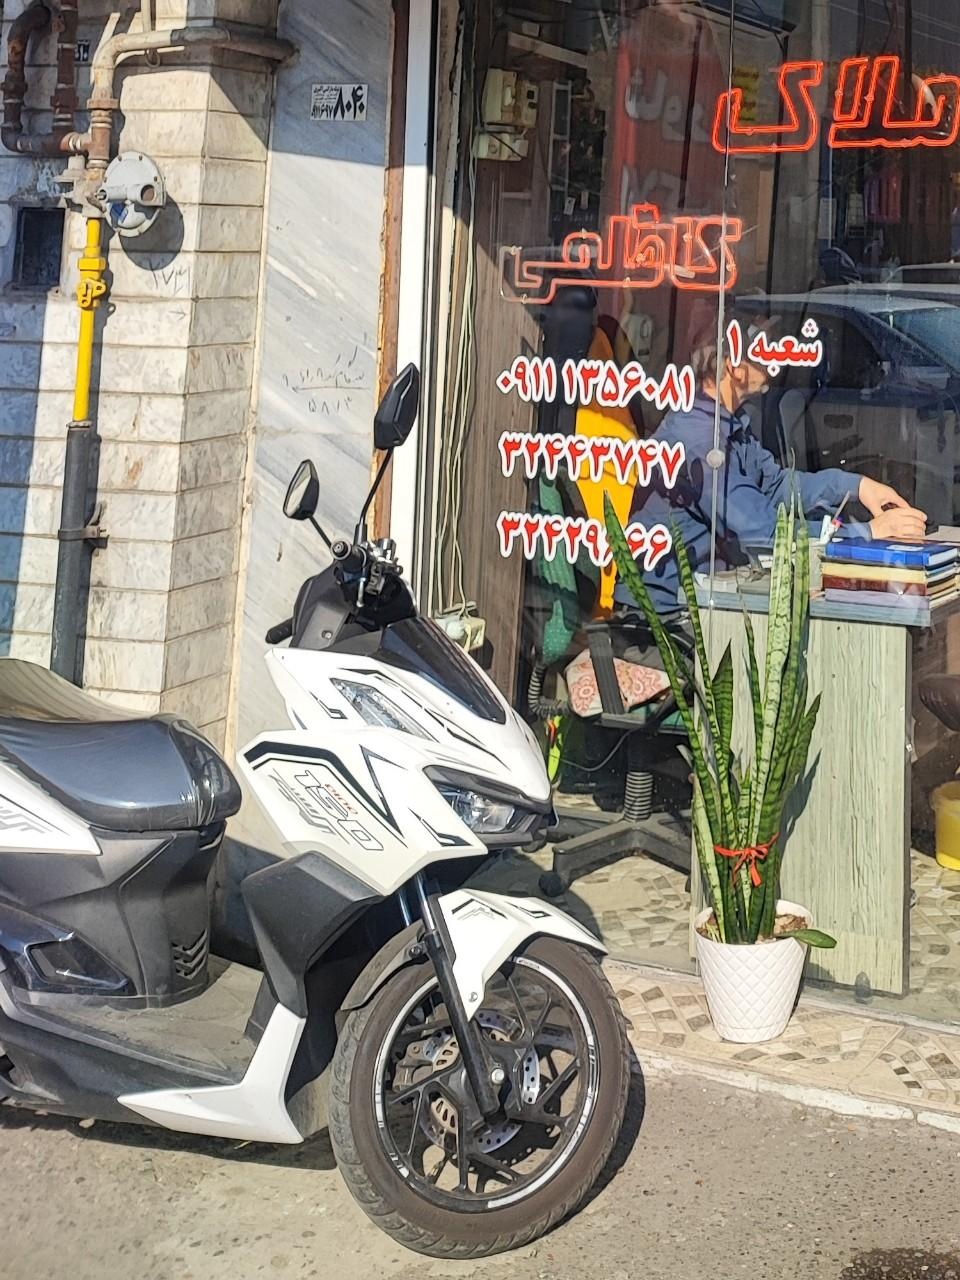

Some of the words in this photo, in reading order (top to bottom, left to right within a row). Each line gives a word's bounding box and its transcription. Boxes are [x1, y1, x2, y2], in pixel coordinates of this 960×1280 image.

[500, 202, 742, 305] کاظمی
[747, 318, 823, 377] شعبه
[496, 510, 673, 572] ۳۲۴۲۹۶۶
